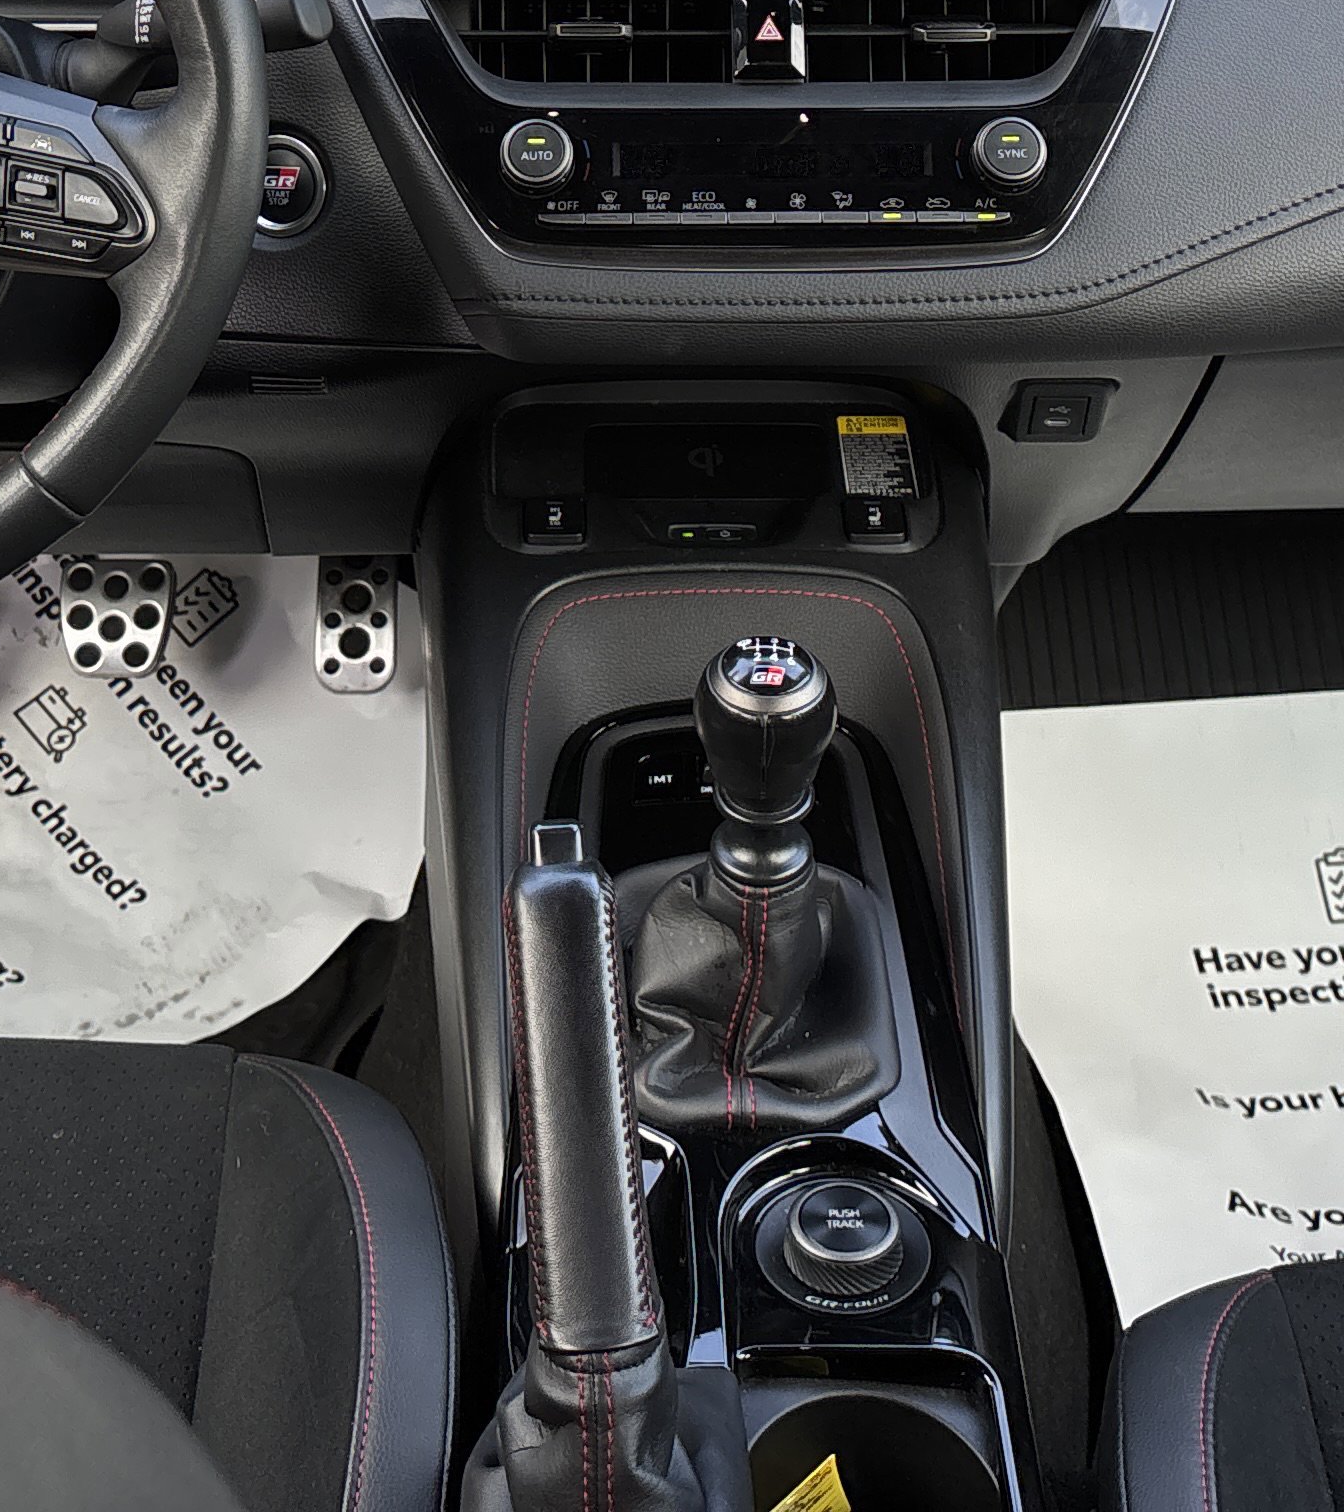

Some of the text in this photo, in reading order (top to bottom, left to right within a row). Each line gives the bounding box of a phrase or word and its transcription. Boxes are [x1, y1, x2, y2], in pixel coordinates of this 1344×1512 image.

[520, 150, 553, 162] AUTO
[997, 148, 1029, 159] SYNC
[73, 193, 102, 205] CANCEL
[266, 190, 290, 198] START
[692, 191, 716, 202] ECO
[558, 201, 580, 211] OFF
[597, 203, 622, 211] FRONT
[646, 203, 667, 211] REAR
[682, 202, 726, 210] HEAT/COOL
[975, 197, 998, 209] A/C
[126, 694, 230, 799] results?
[191, 711, 263, 776] your
[32, 792, 148, 911] charged?
[1192, 945, 1287, 975] Have
[1196, 1088, 1230, 1109] Is
[1234, 1090, 1324, 1119] your
[1226, 1188, 1294, 1225] Are
[827, 1208, 861, 1218] PUSH
[825, 1219, 865, 1229] TRACK
